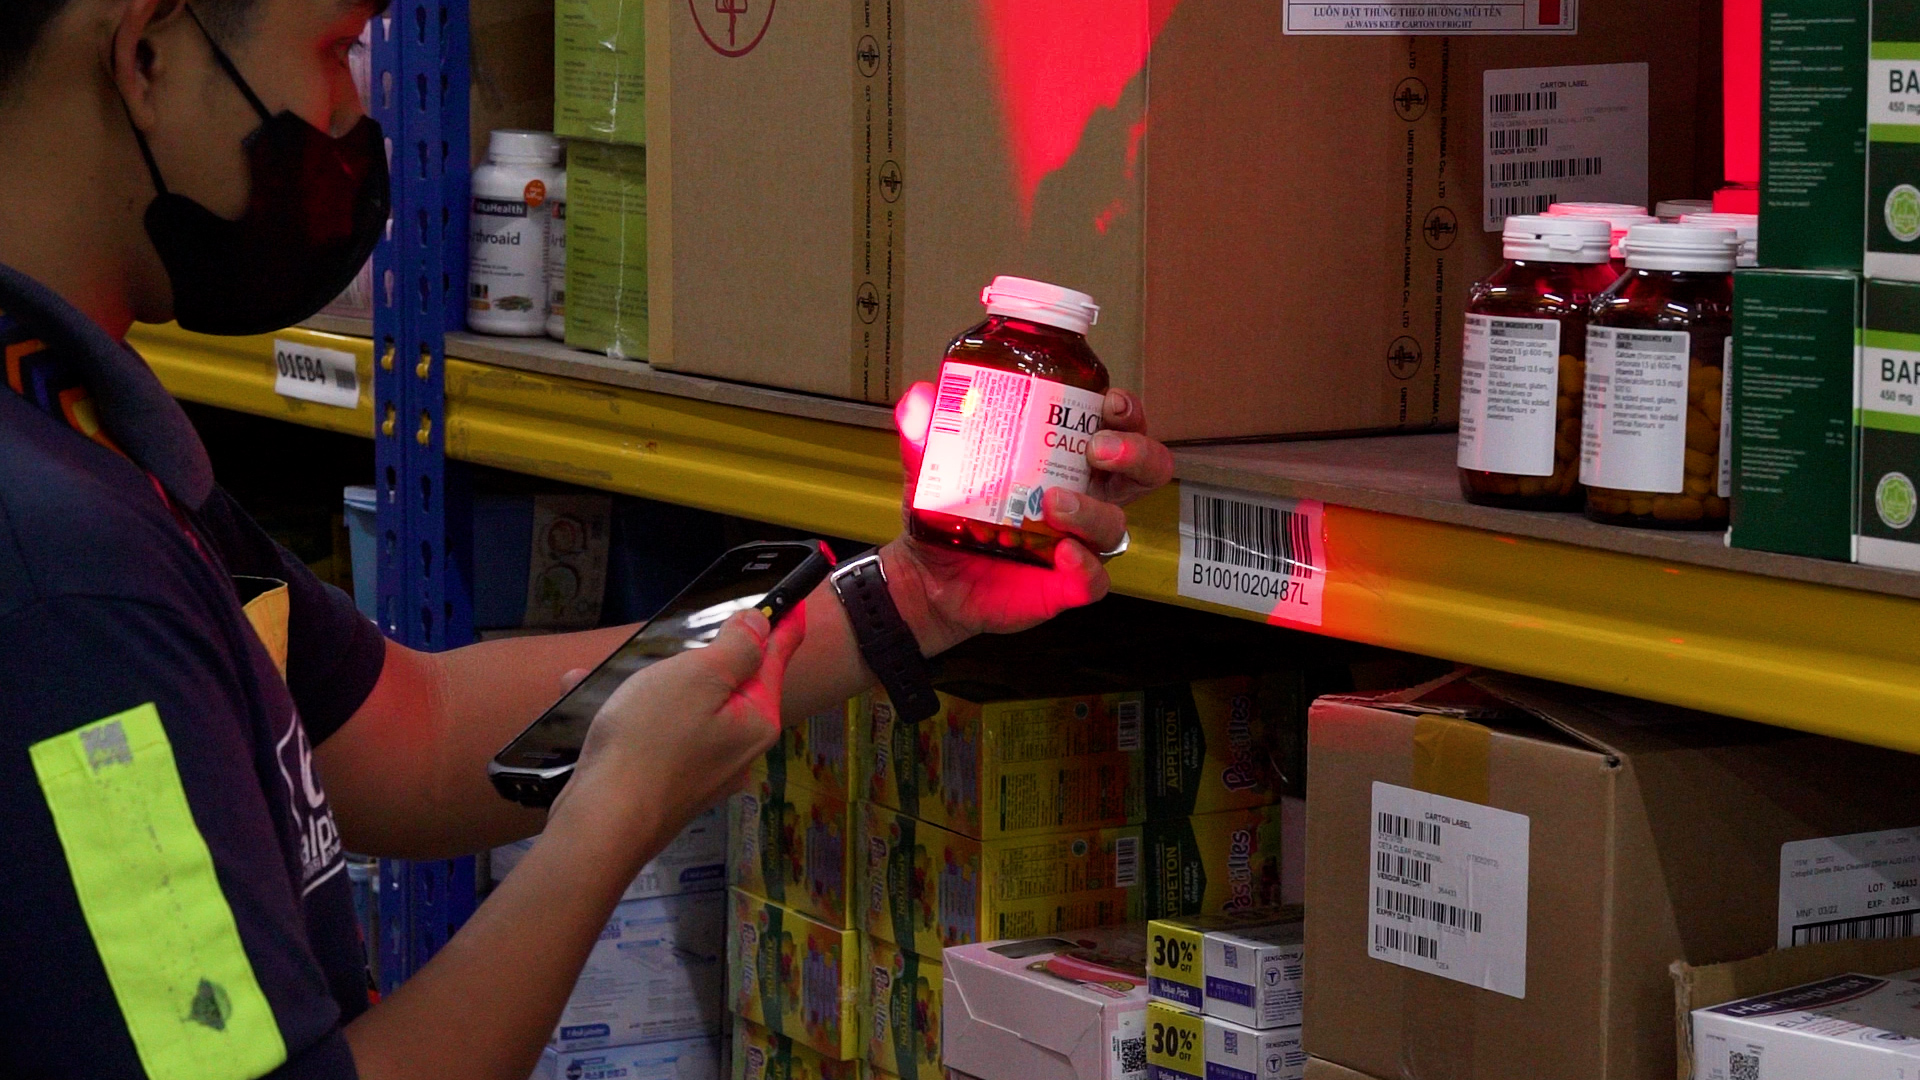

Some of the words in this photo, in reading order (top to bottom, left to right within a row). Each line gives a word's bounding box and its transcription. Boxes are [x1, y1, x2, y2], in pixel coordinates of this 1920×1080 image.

[1399, 7, 1425, 17] THEO
[1345, 20, 1378, 29] ALWAYS
[1379, 20, 1400, 29] KEEP
[1401, 20, 1435, 29] CARTON
[1436, 20, 1473, 29] UPRIGHT
[1540, 81, 1567, 89] CARTON
[1568, 80, 1589, 88] LABEL
[1888, 101, 1904, 113] 450
[1440, 117, 1448, 158] PHARMA
[1407, 129, 1415, 165] UNITED
[1438, 181, 1446, 199] LTD
[1404, 166, 1413, 244] INTERNATIONAL
[1403, 246, 1411, 289] PHARMA
[1433, 295, 1442, 372] INTERNATIONAL
[1490, 338, 1508, 346] Calcium
[277, 351, 326, 384] 01EB4
[1432, 374, 1441, 412] PHARMA
[1880, 391, 1895, 402] 450
[1897, 392, 1913, 405] mg
[1399, 387, 1408, 422] UNITED
[1507, 405, 1528, 414] flavours
[1044, 459, 1067, 470] Contains
[1192, 563, 1309, 605] B1001020487L
[1166, 711, 1179, 789] APPETON
[1222, 696, 1257, 792] Pastilles
[1425, 812, 1451, 826] CARTON
[1452, 817, 1472, 830] LABEL
[1833, 865, 1845, 873] Skin
[1377, 872, 1400, 883] VENDOR
[1868, 882, 1886, 893] LOT:
[1892, 878, 1918, 889] 364433
[1818, 905, 1838, 916] 03/22
[1867, 899, 1885, 909] EXP:
[1376, 908, 1396, 917] EXPIRY
[1264, 952, 1299, 963] SENSODYNE
[1180, 964, 1192, 973] OFF
[1160, 981, 1176, 995] Value
[1176, 986, 1190, 998] Pack
[1266, 1038, 1299, 1049] SENSODYNE
[1179, 1052, 1192, 1062] OFF
